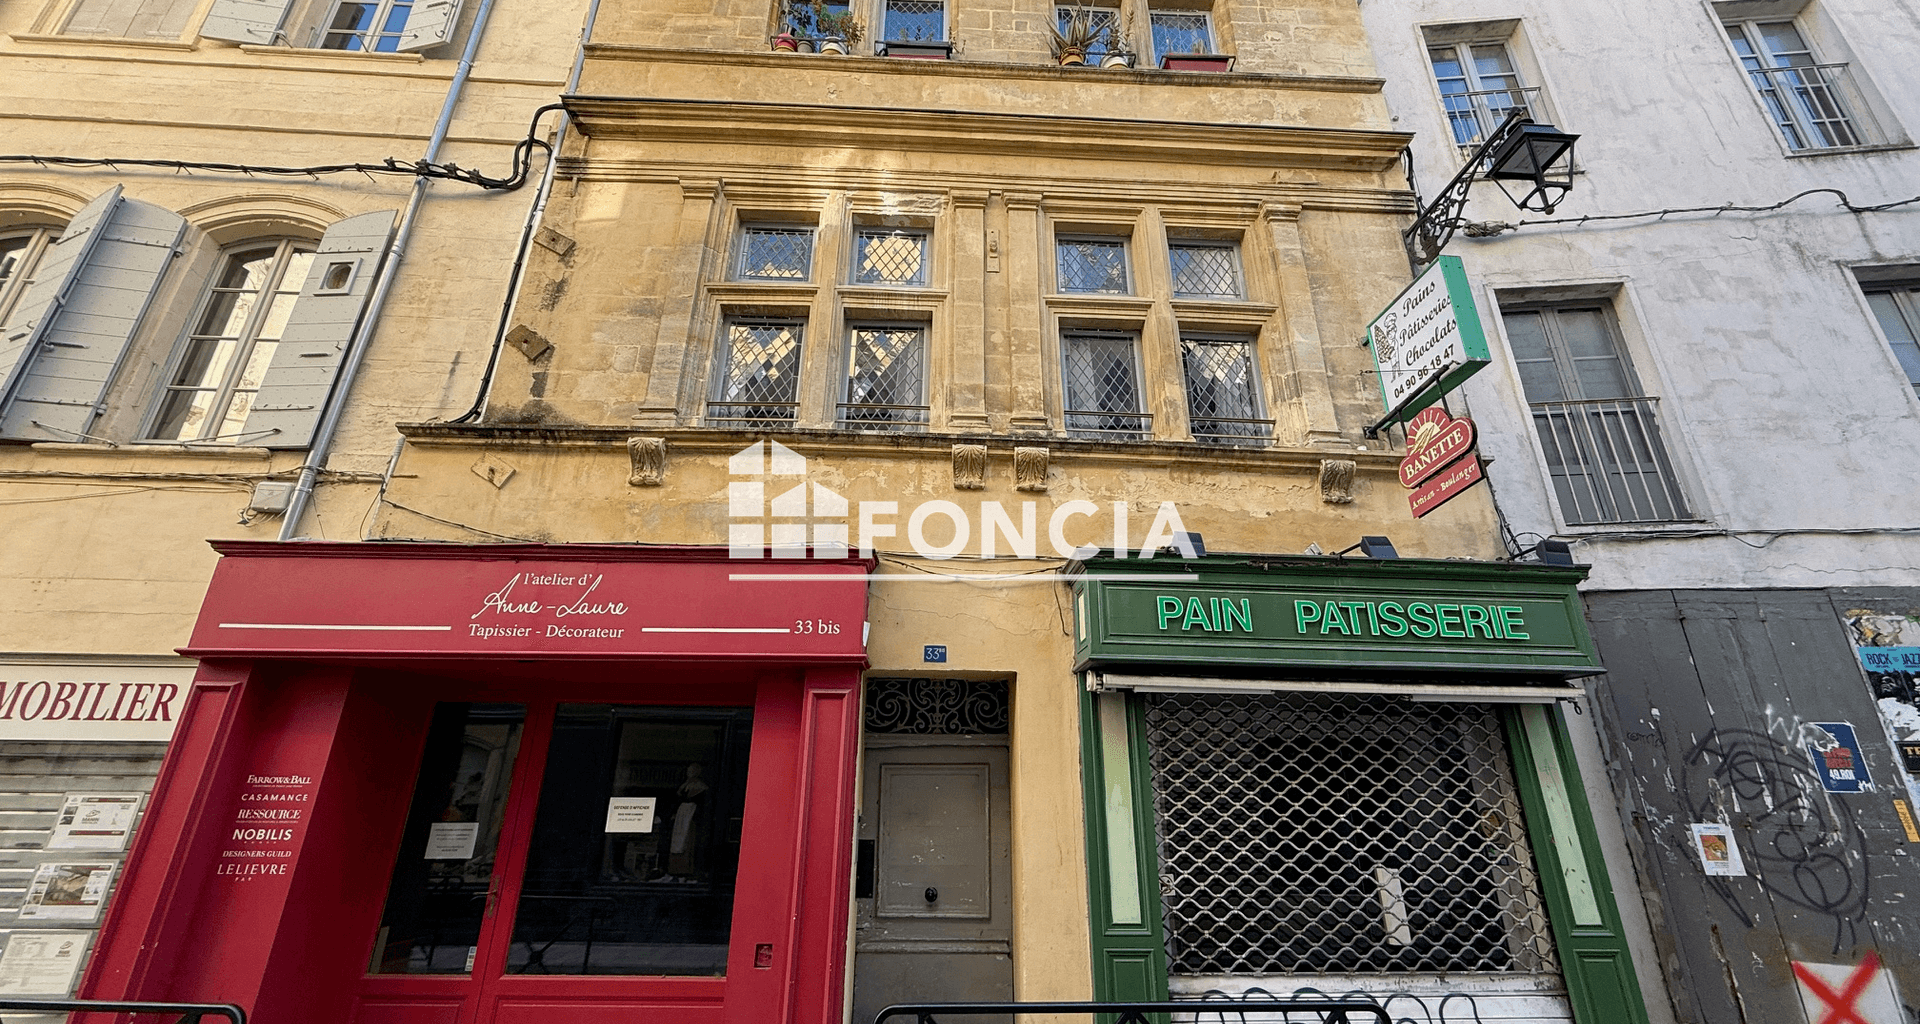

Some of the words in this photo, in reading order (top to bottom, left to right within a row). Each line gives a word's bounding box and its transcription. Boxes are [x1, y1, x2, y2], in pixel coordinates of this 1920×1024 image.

[1403, 281, 1435, 317] Pains
[1400, 295, 1452, 347] Pâtisseries
[1405, 318, 1457, 366] Chocolats
[1394, 384, 1404, 398] 04
[1405, 375, 1416, 389] 90
[1417, 365, 1429, 380] 96
[1430, 355, 1441, 369] 18
[1443, 343, 1454, 359] 47
[1404, 428, 1463, 480] BANETTE
[1440, 462, 1476, 491] Boulanger
[524, 573, 575, 585] l'atelier
[1156, 595, 1253, 632] PAIN
[1294, 600, 1530, 640] PATISSERIE
[468, 624, 531, 639] Tapissier
[545, 625, 624, 638] Décorateur
[794, 620, 813, 634] 33
[818, 619, 841, 634] bis
[1865, 653, 1893, 665] ROCK
[247, 775, 312, 784] FARROW&BALL
[237, 809, 302, 819] RESSOURCE
[232, 829, 292, 840] NOBILIS
[217, 864, 288, 875] LELIEVRE
